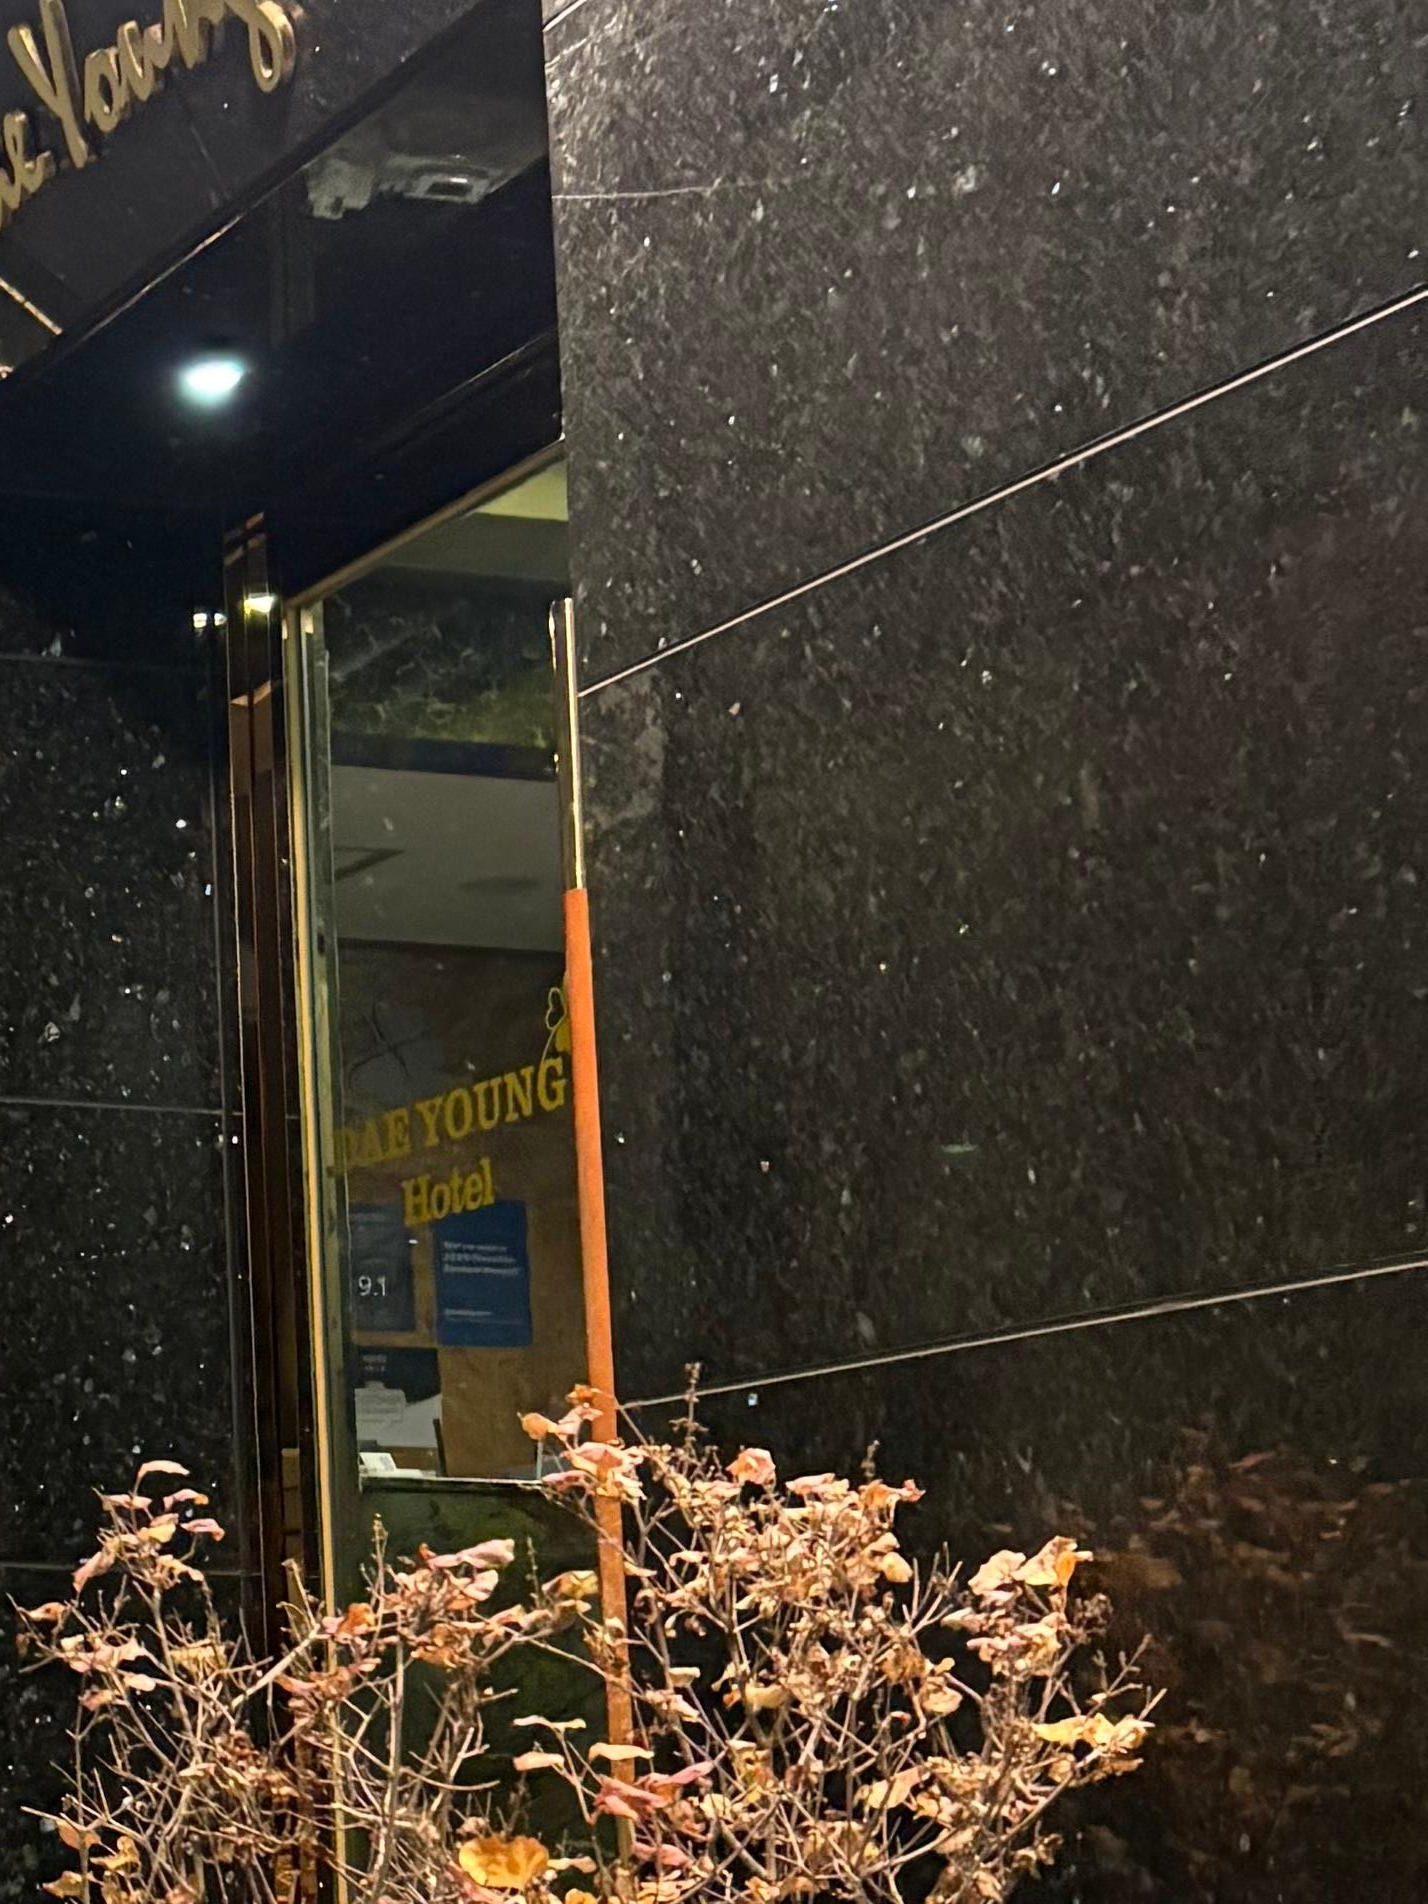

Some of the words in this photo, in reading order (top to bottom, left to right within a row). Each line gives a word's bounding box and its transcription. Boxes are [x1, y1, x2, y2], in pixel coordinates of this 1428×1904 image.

[331, 1107, 411, 1175] DAE
[415, 1057, 566, 1146] YOUNG
[401, 1156, 495, 1226] Hotel
[357, 1274, 388, 1297] 9.1
